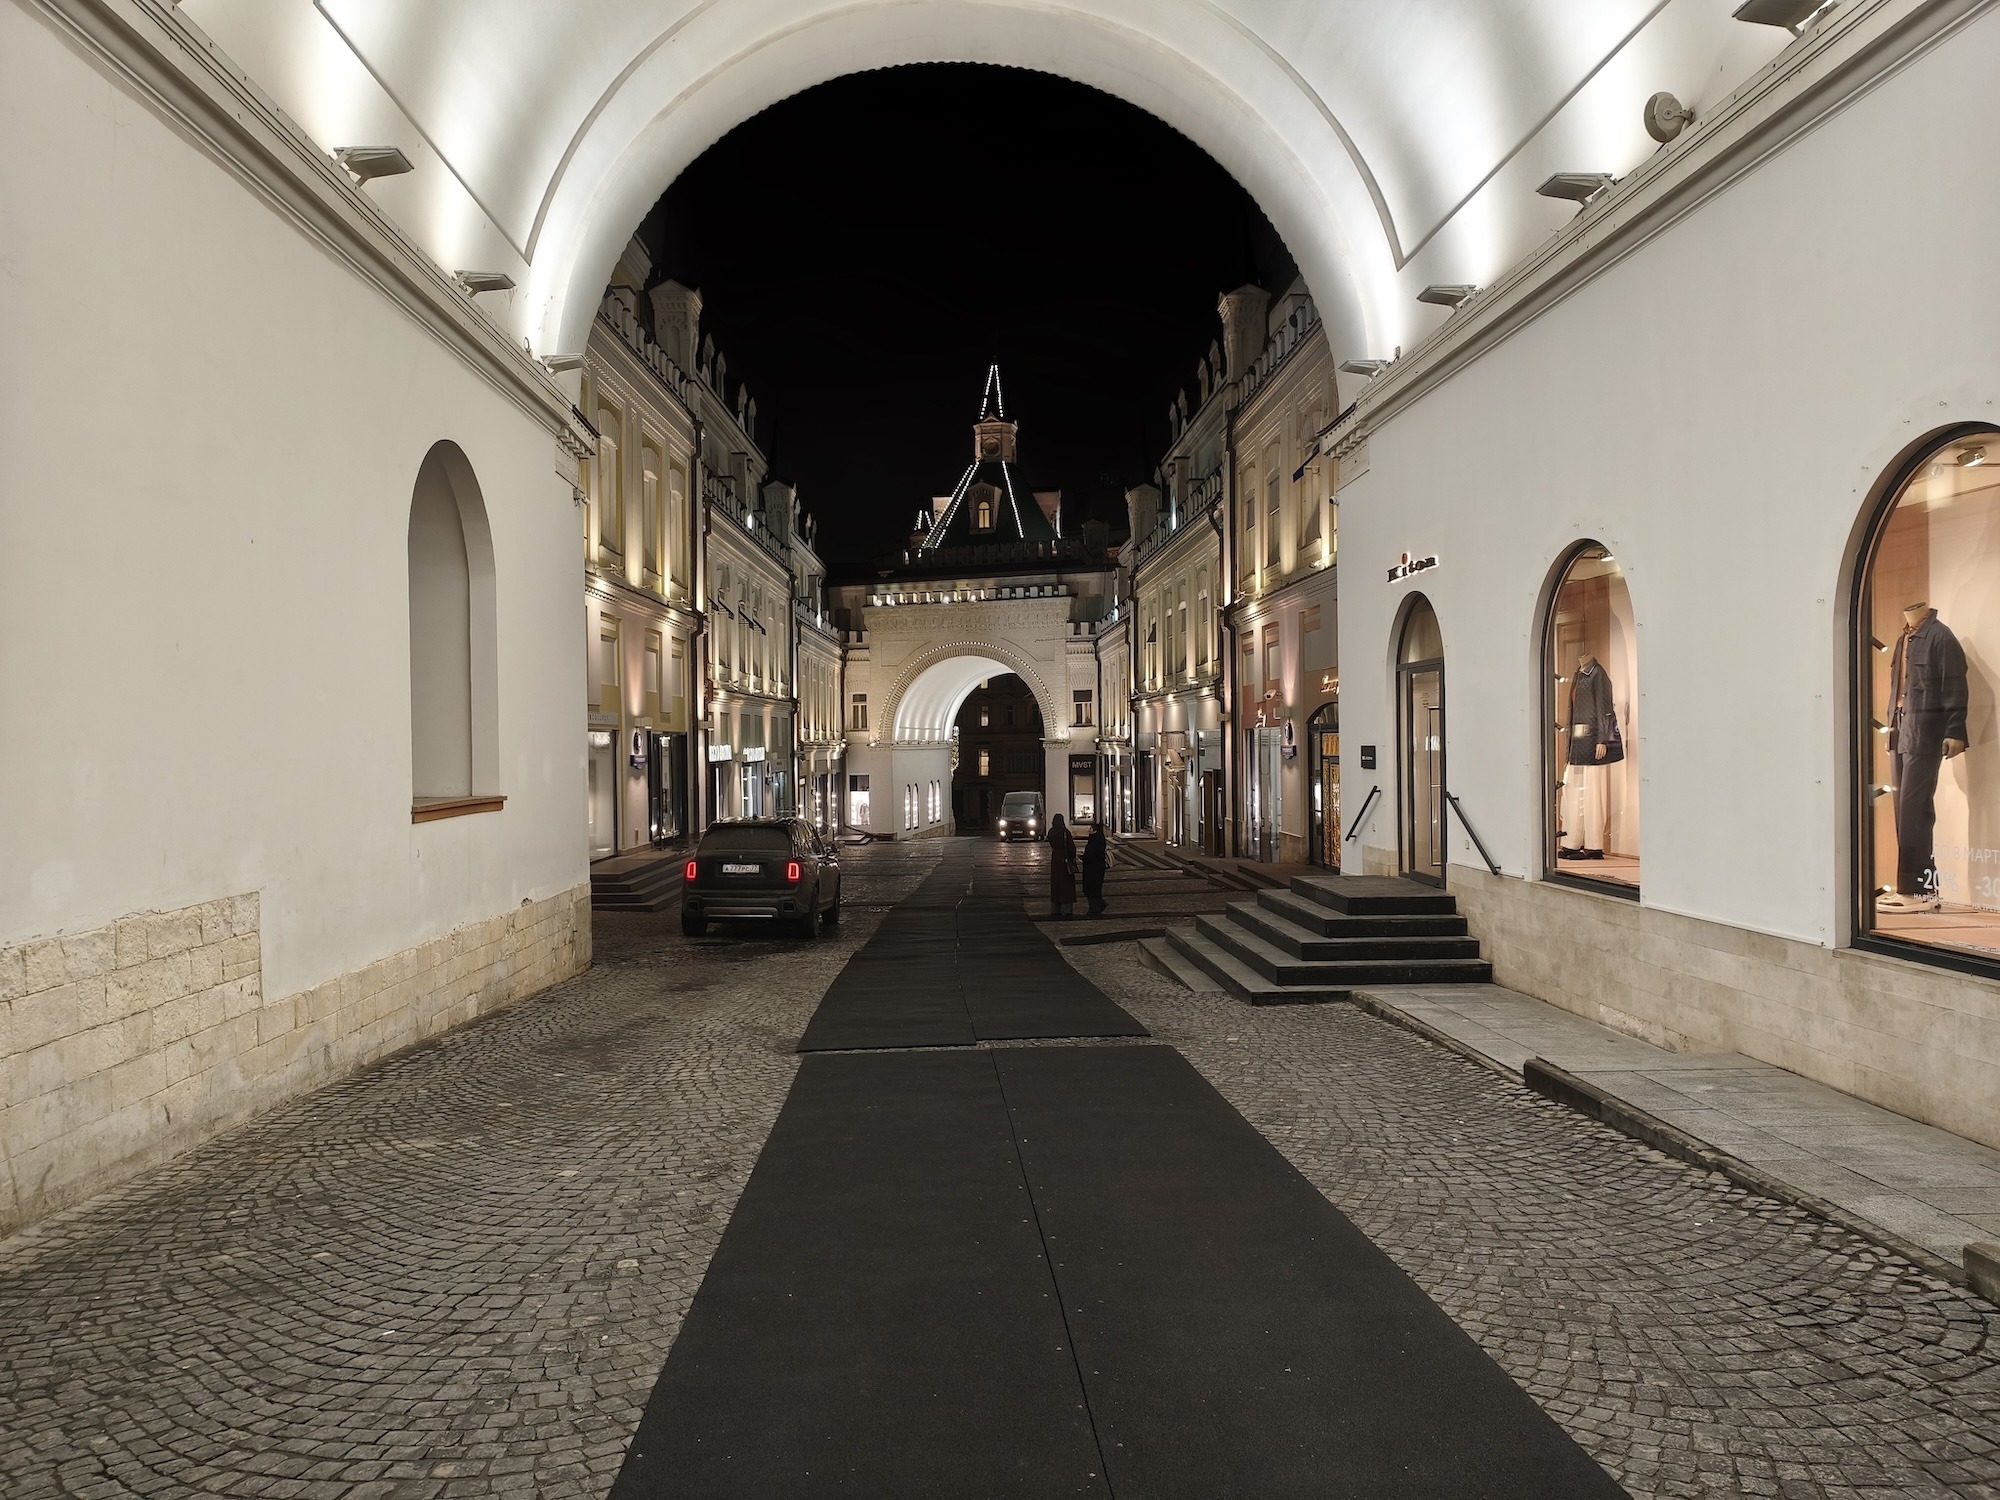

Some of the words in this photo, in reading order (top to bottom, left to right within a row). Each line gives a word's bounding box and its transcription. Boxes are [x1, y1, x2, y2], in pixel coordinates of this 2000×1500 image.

[1387, 553, 1437, 583] Kiton
[1072, 761, 1092, 769] MVST
[1953, 846, 1960, 860] 8
[1965, 847, 2000, 864] МАРТ
